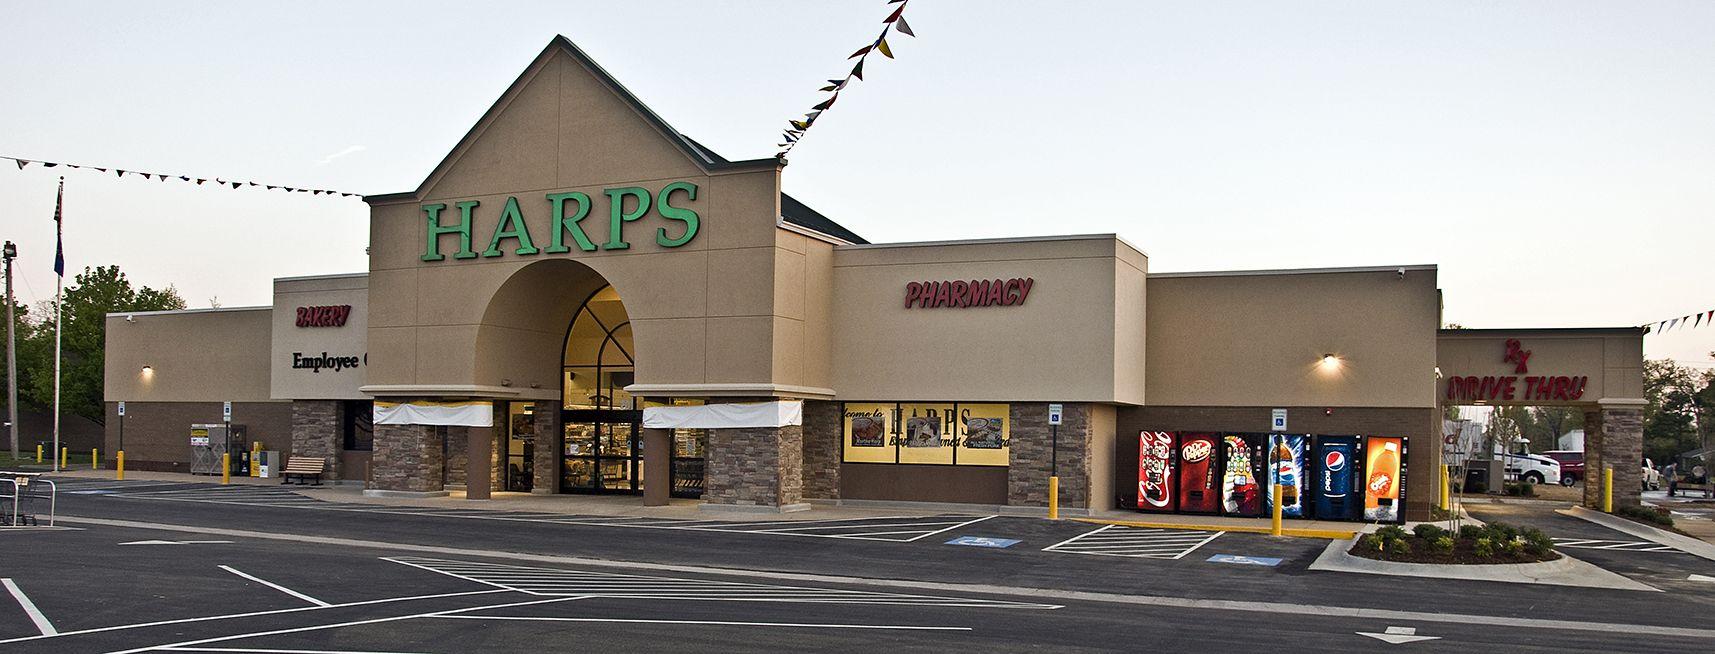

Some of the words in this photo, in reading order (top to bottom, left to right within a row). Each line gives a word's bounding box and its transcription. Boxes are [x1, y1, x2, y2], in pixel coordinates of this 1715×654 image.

[421, 181, 700, 261] HARPS
[904, 277, 1034, 309] PHARMACY
[296, 304, 352, 328] BAKERY
[292, 351, 359, 373] Employee
[1447, 376, 1518, 400] DRIVE
[1524, 376, 1588, 401] THRU
